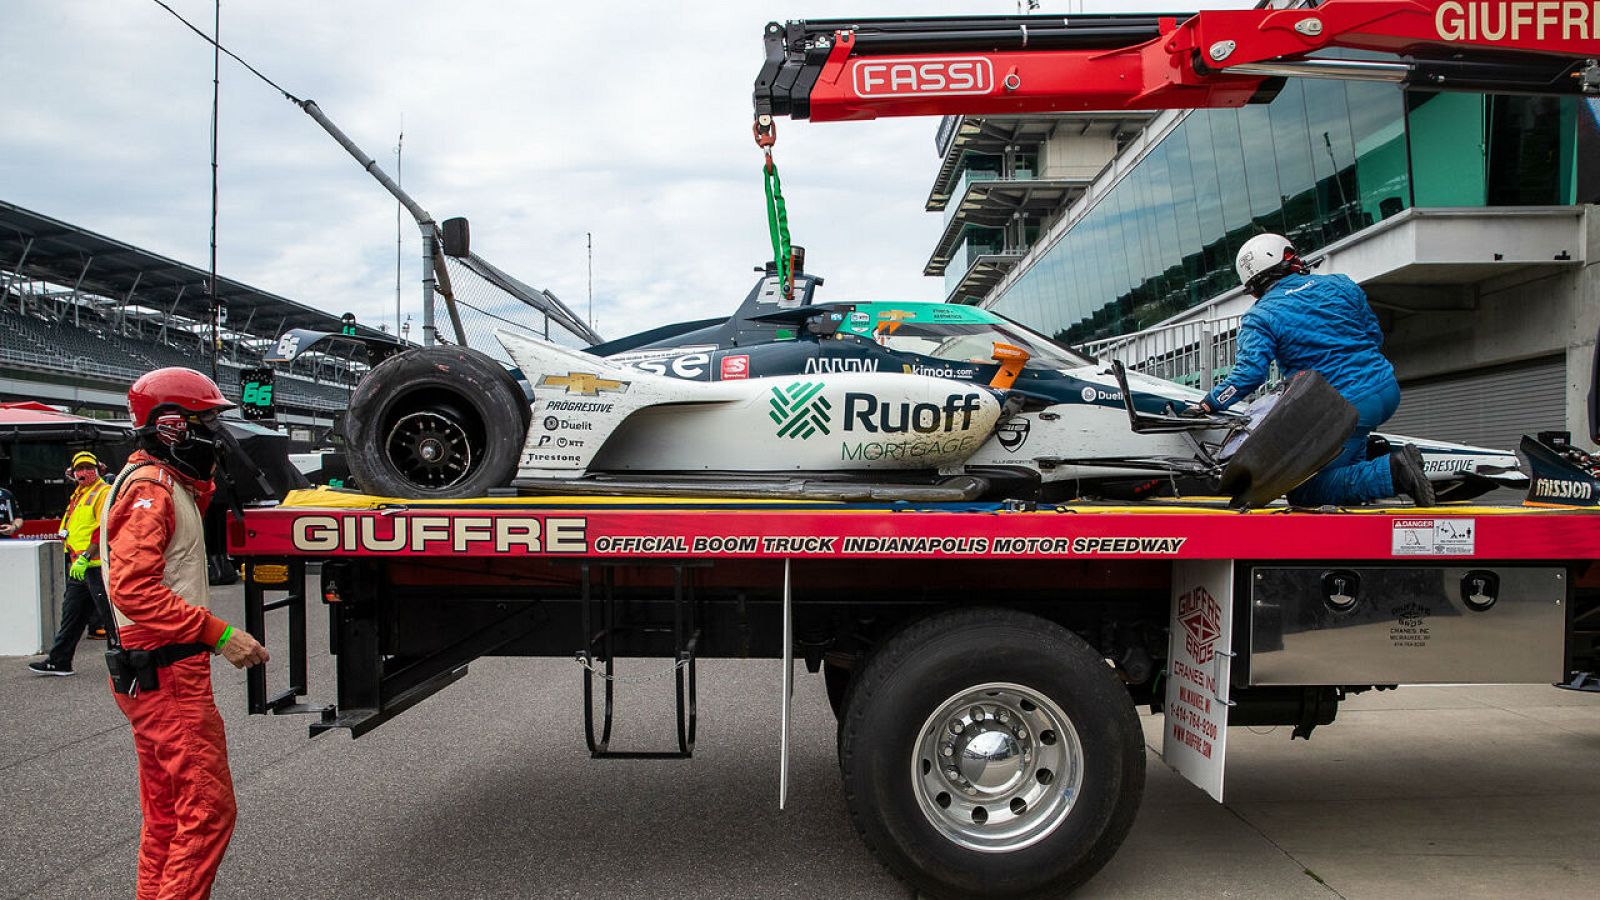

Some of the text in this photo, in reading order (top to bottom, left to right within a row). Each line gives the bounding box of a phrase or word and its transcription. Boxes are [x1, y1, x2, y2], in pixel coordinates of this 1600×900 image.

[1435, 1, 1600, 41] GIUFFR
[864, 63, 983, 91] FASSI
[277, 333, 300, 361] 66
[804, 358, 879, 374] ARROW
[244, 382, 272, 406] 66
[1098, 390, 1124, 401] Dueli
[545, 401, 614, 413] PROGRESSIVE
[843, 392, 981, 433] Ruoff
[560, 420, 592, 431] Duelit
[528, 453, 581, 462] Firestone
[841, 437, 975, 461] MORTGAGE
[1423, 459, 1475, 473] GRESSIVE
[1536, 478, 1592, 499] MISSION
[291, 516, 588, 553] GIUFFRE
[595, 536, 1186, 554] OFFICIAL BOOM TRUCK INDIANAPOLIS MOTOR SPEEDWAY
[1186, 633, 1213, 664] BROS
[1174, 660, 1204, 688] CRANES
